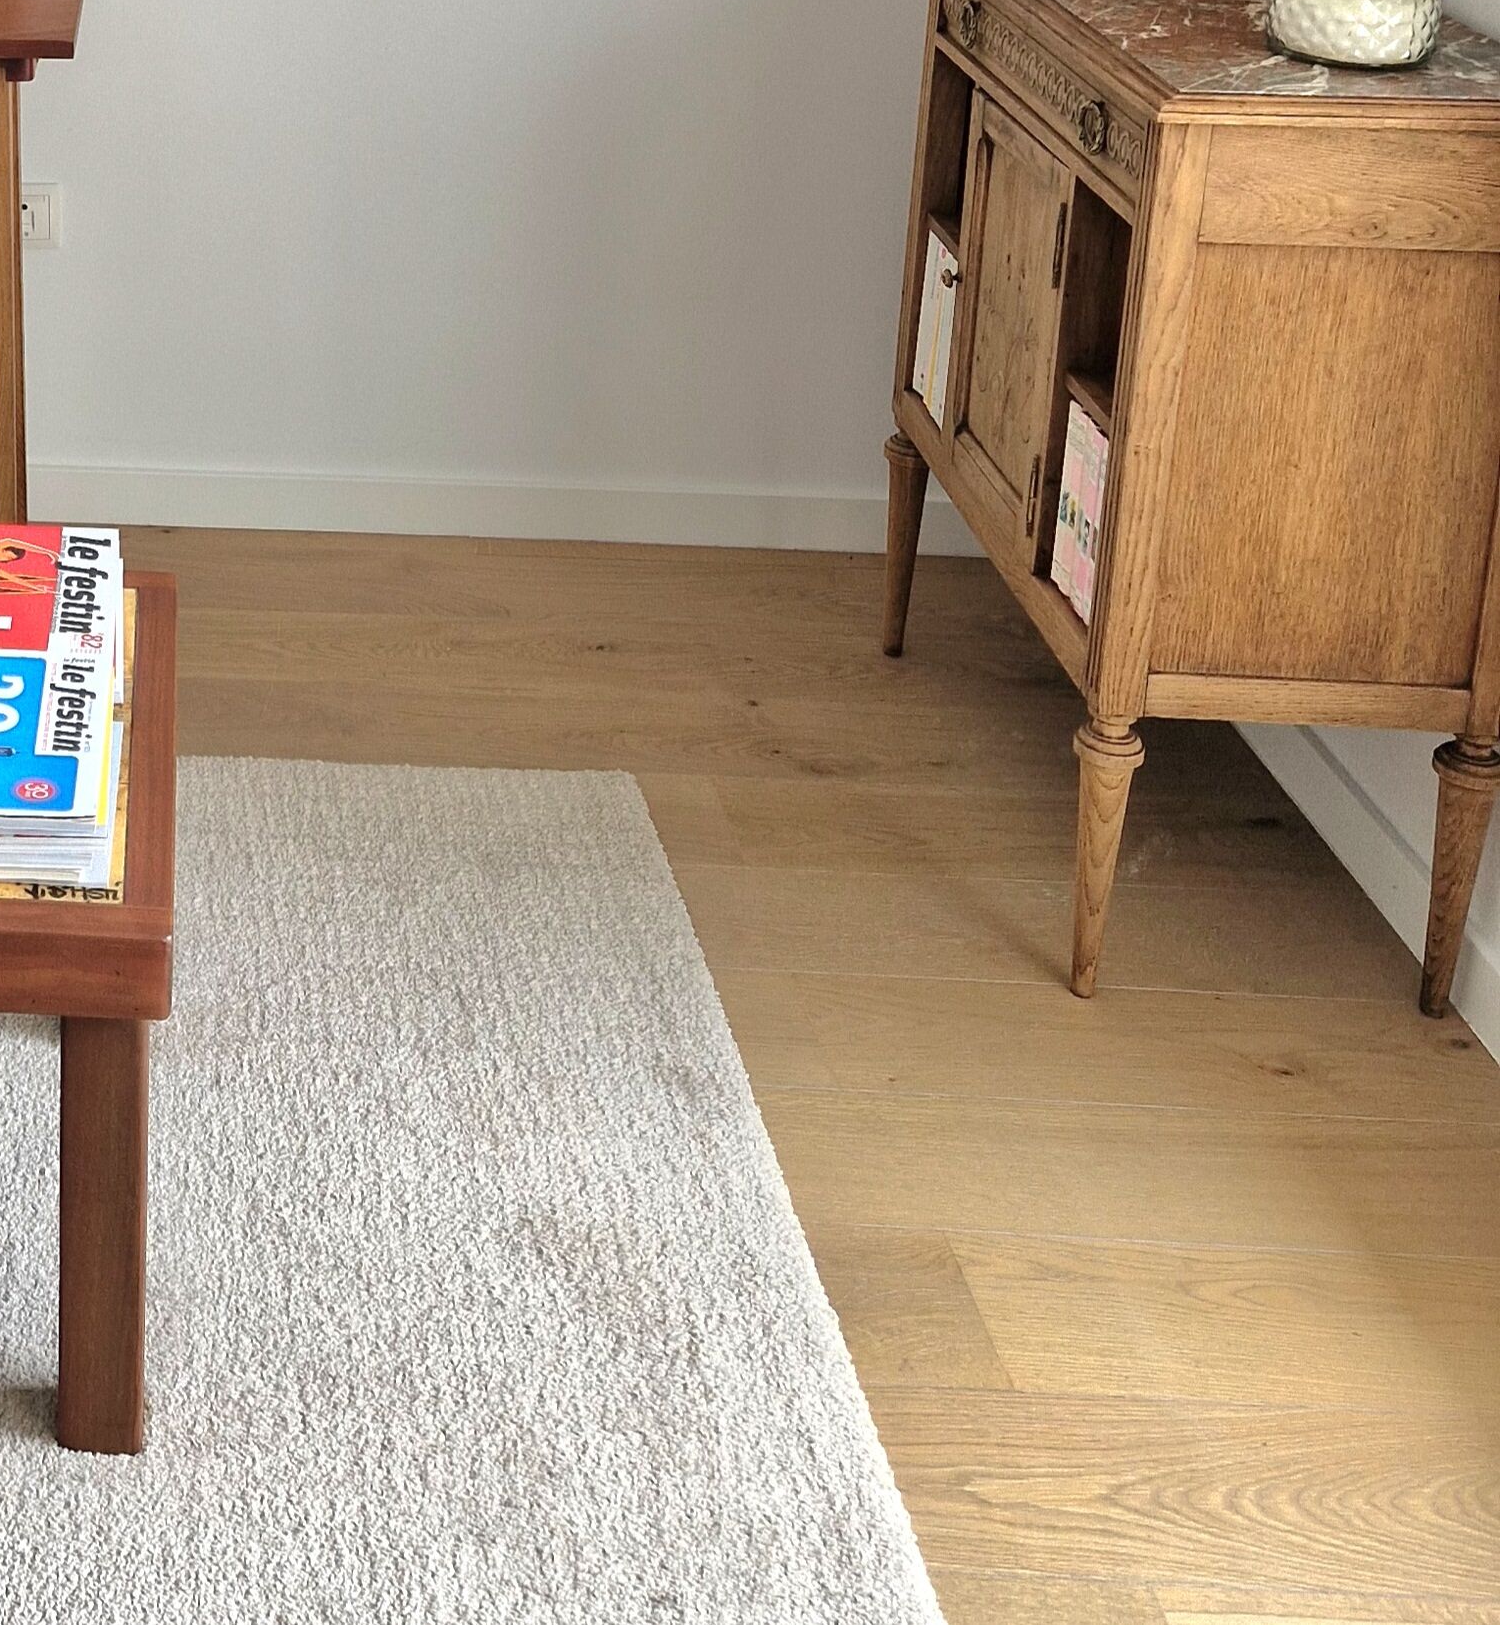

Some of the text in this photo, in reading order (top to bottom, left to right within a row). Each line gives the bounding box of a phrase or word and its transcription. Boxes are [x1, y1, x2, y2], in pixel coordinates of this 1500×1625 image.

[67, 535, 112, 561] le
[56, 561, 109, 633] festin
[61, 663, 95, 683] le
[49, 682, 97, 752] festin
[24, 782, 49, 799] 30
